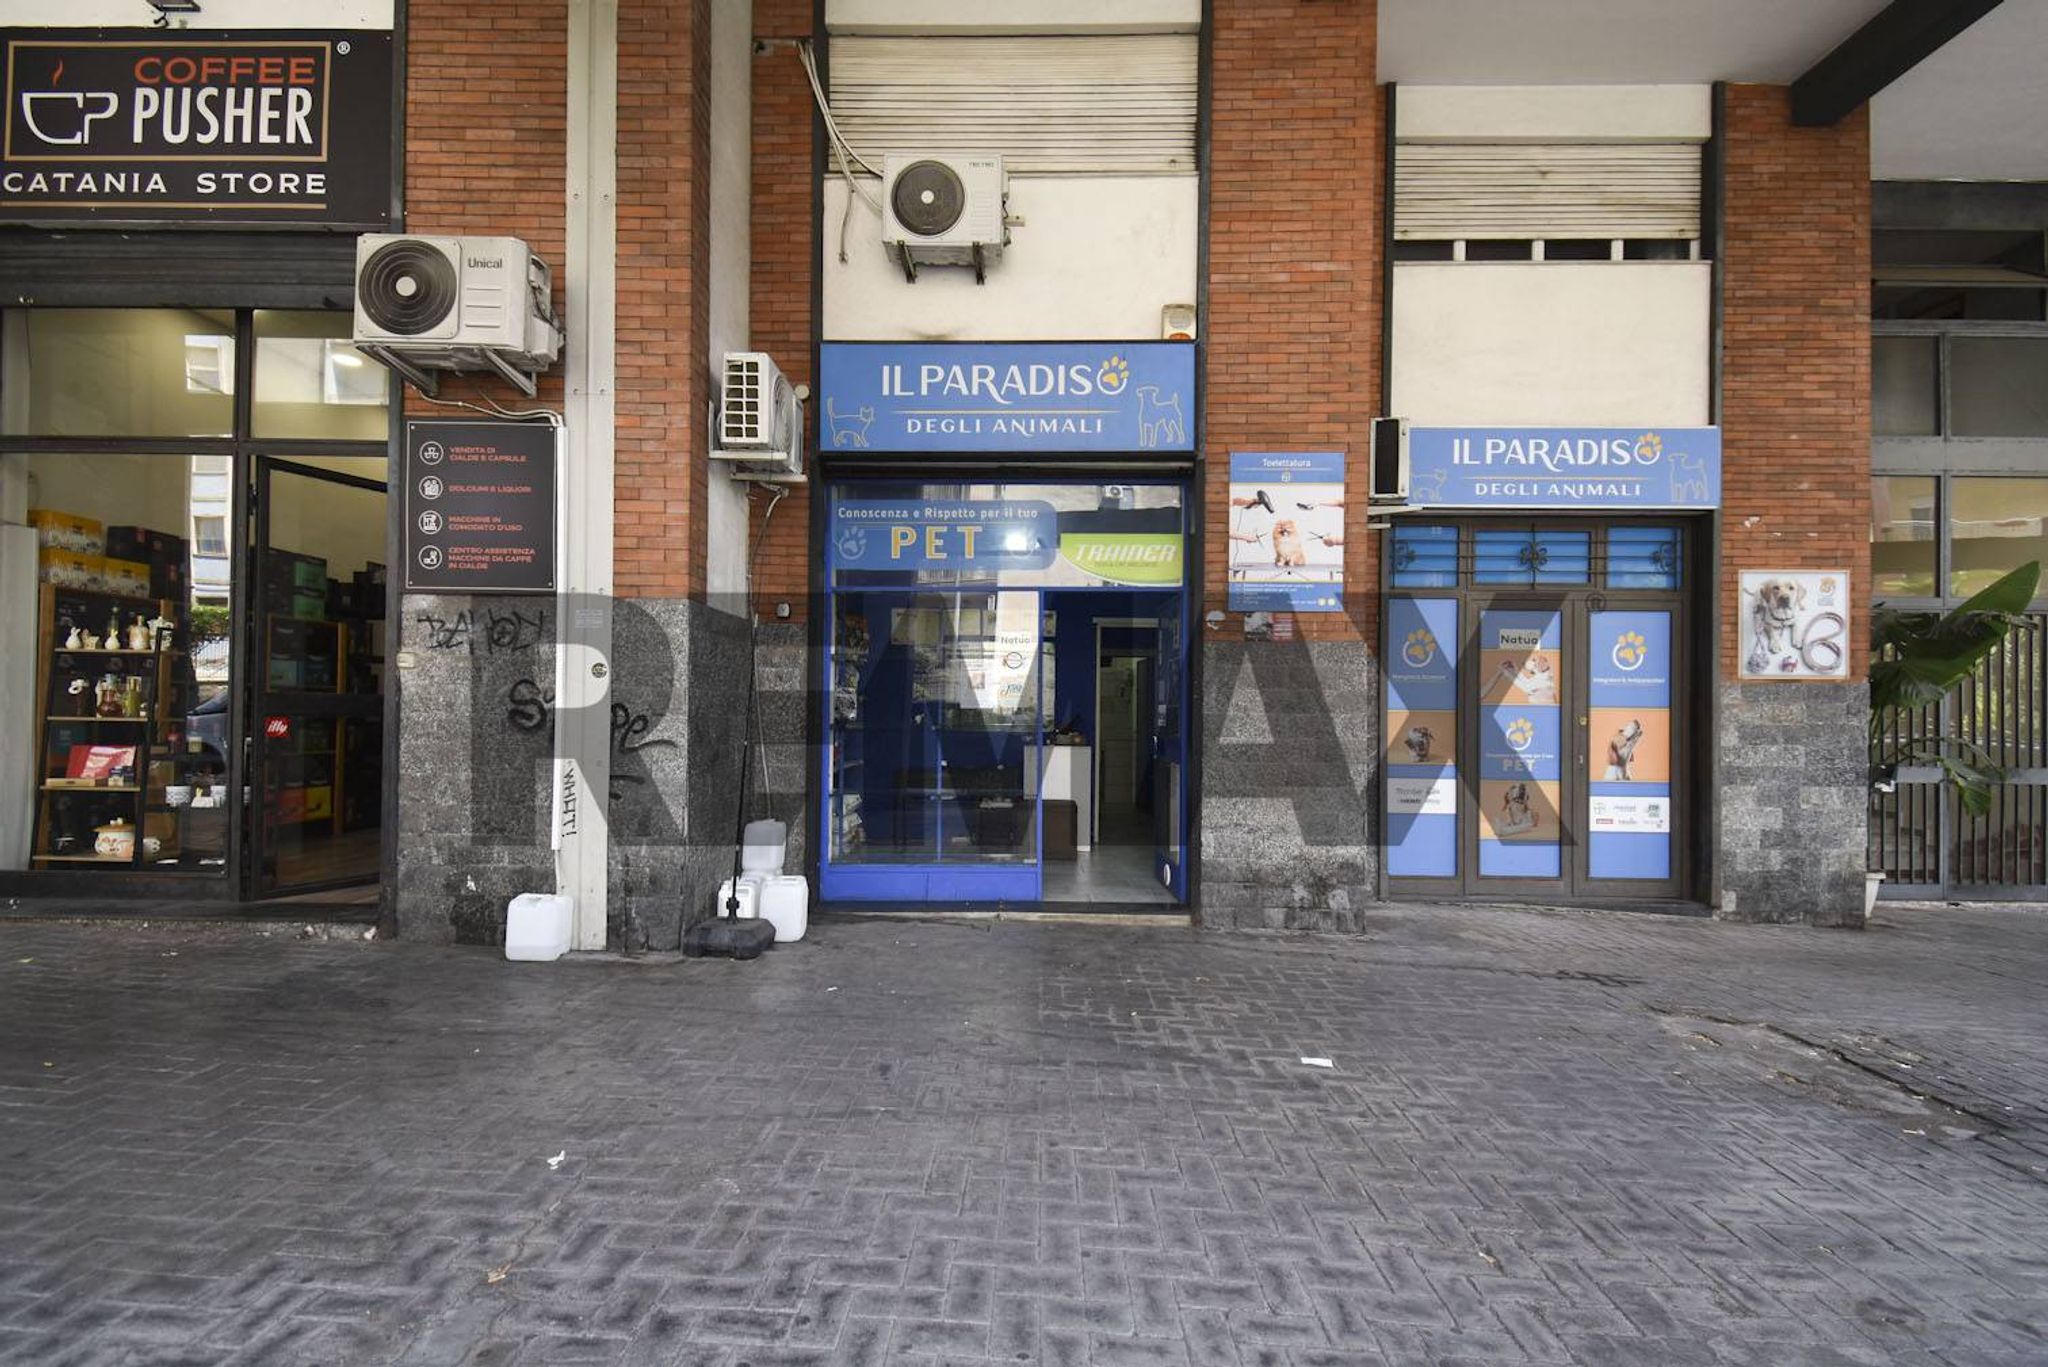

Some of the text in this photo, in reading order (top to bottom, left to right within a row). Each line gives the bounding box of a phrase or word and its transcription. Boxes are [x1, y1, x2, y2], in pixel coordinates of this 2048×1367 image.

[134, 56, 316, 84] COFFEE
[132, 86, 313, 145] PUSHER
[3, 172, 327, 195] CATANIA STORE
[468, 257, 502, 268] Unical
[907, 418, 1103, 437] DEGLI ANIMALI
[449, 446, 486, 454] VENDITA
[449, 454, 478, 462] CIALDE
[487, 455, 526, 463] CAPSULE
[1475, 483, 1641, 499] DEGLI ANIMALI
[838, 506, 1038, 521] Conoscenza e Rispetto per il tuo
[890, 526, 983, 560] PET
[1500, 634, 1539, 645] Natua
